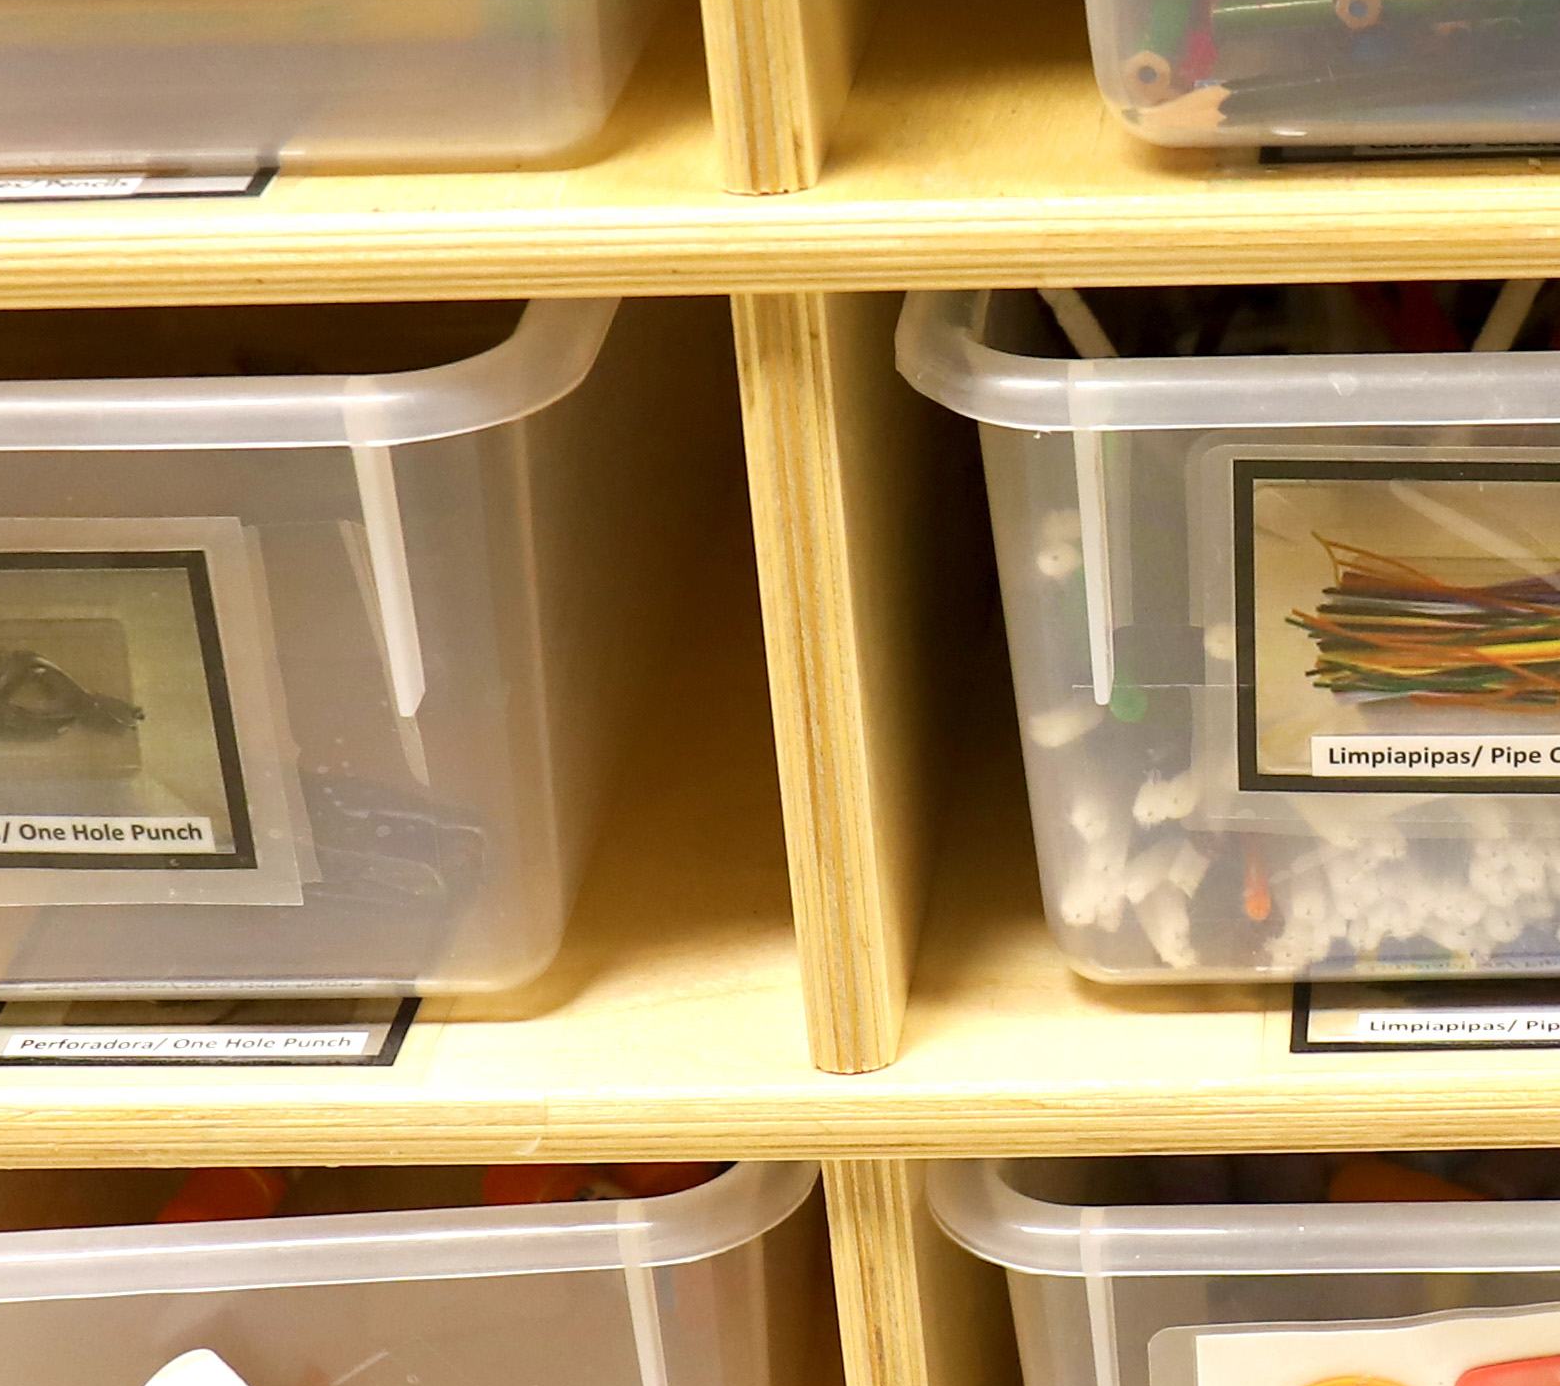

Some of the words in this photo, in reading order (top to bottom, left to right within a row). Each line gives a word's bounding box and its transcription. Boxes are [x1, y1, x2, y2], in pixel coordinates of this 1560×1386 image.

[1329, 746, 1483, 767] Limpiapipas/
[1491, 747, 1541, 767] Pipe
[19, 824, 65, 842] One
[73, 824, 124, 841] Hole
[132, 824, 202, 841] Punch
[1370, 1020, 1517, 1033] Limpiapipas/
[19, 1038, 166, 1051] Perforadora/
[172, 1038, 217, 1049] One
[225, 1038, 275, 1049] Hole
[283, 1037, 351, 1048] Punch
